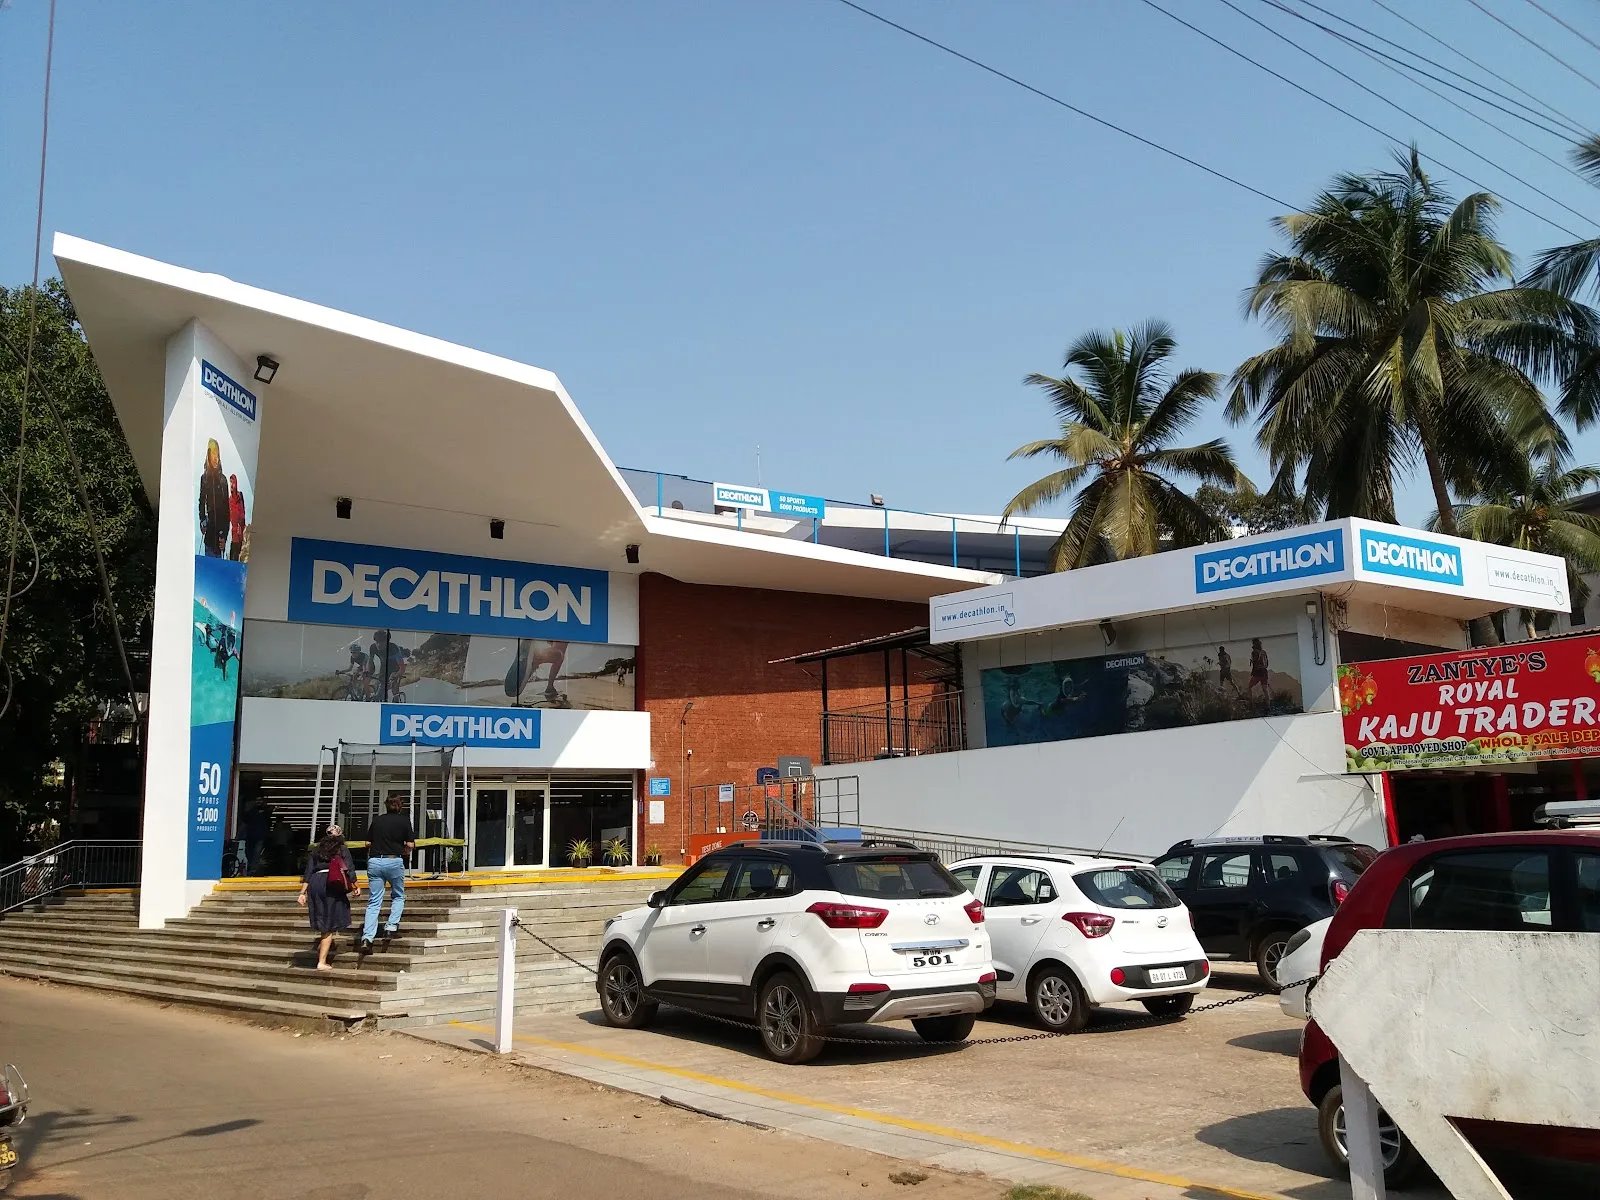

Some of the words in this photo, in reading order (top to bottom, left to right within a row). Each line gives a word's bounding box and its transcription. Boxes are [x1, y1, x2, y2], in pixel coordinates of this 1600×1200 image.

[204, 366, 254, 413] DECATHLON
[719, 490, 761, 504] DECATHLON
[779, 495, 786, 503] 50
[787, 496, 806, 505] SPORTS
[779, 503, 792, 511] 5000
[792, 505, 818, 515] PRODUCTS
[1203, 540, 1334, 584] DECATHLON
[1366, 539, 1458, 576] DECATHLON
[1494, 569, 1554, 587] www.decathlon.in
[311, 559, 592, 625] DECATHLON
[941, 604, 1005, 622] www.decathlon.in
[1105, 656, 1145, 669] DECATHLON
[1407, 651, 1547, 684] ZANTYE'S
[1438, 678, 1519, 706] ROYAL
[390, 713, 532, 740] DECATHLON
[1358, 711, 1442, 742] KAJU
[1455, 697, 1600, 735] TRADER
[1389, 742, 1440, 756] APPROVED
[1441, 740, 1468, 752] SHOP
[1479, 735, 1529, 749] WHOLE
[1533, 731, 1568, 746] SALE
[1454, 753, 1479, 761] Cashew
[198, 761, 221, 796] 50
[197, 796, 219, 805] SPORTS
[196, 807, 218, 825] 5,000
[913, 954, 953, 968] 501
